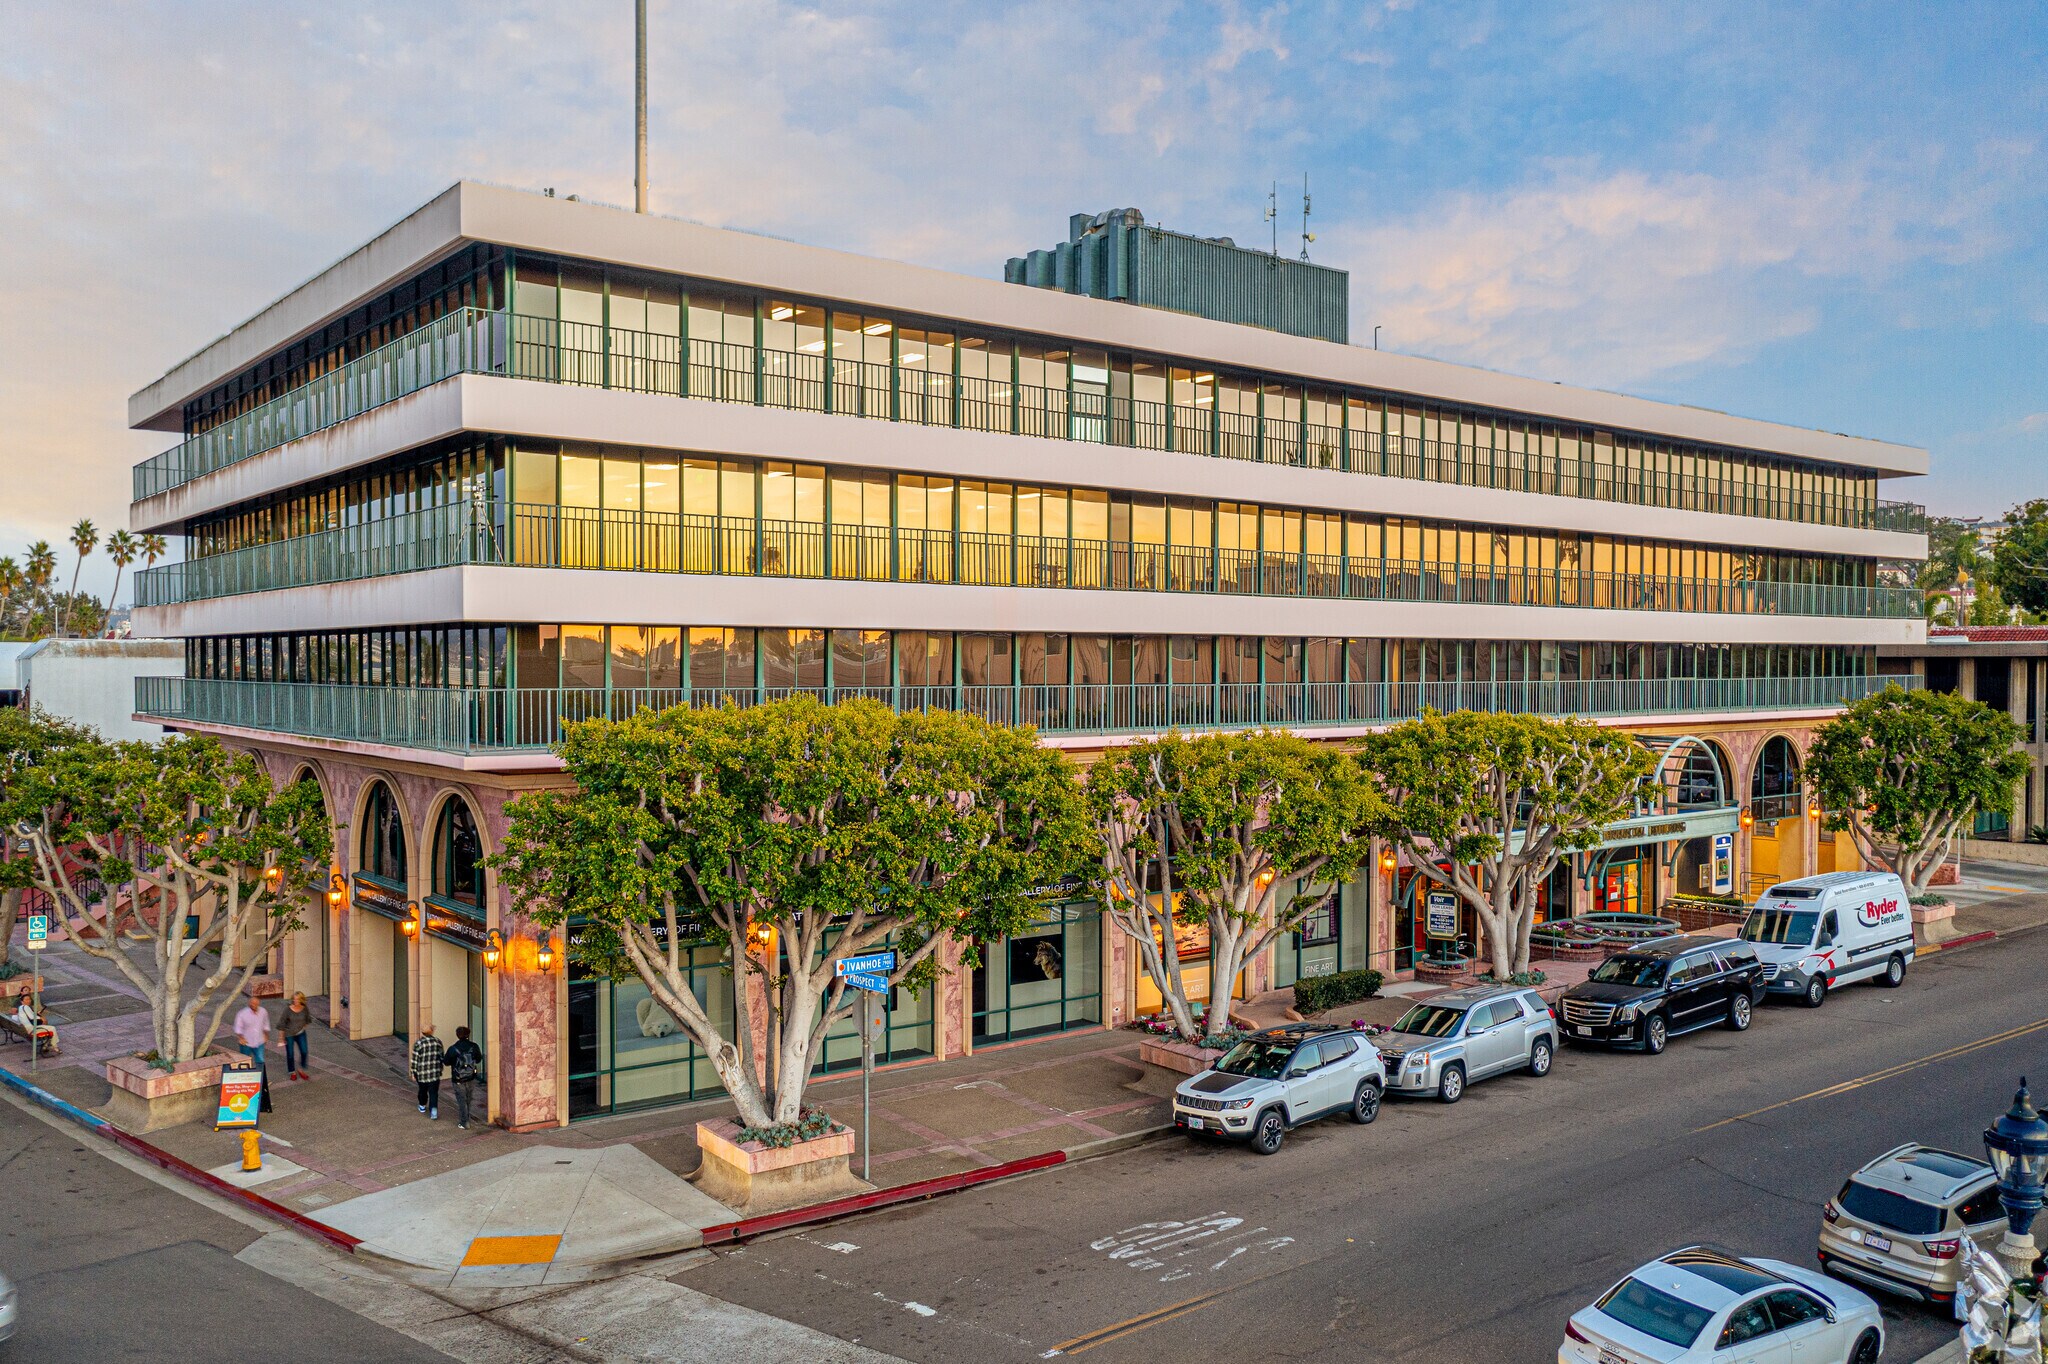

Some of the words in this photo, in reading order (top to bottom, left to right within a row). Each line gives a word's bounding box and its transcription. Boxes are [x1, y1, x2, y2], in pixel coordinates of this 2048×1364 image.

[1054, 884, 1064, 893] OF
[1866, 898, 1897, 920] Ryder
[1881, 916, 1891, 925] Ever
[847, 959, 881, 972] IVANHOE
[1304, 964, 1320, 974] FINE
[1320, 962, 1334, 971] ART
[850, 974, 875, 987] PROSPECT
[1189, 984, 1204, 993] ART
